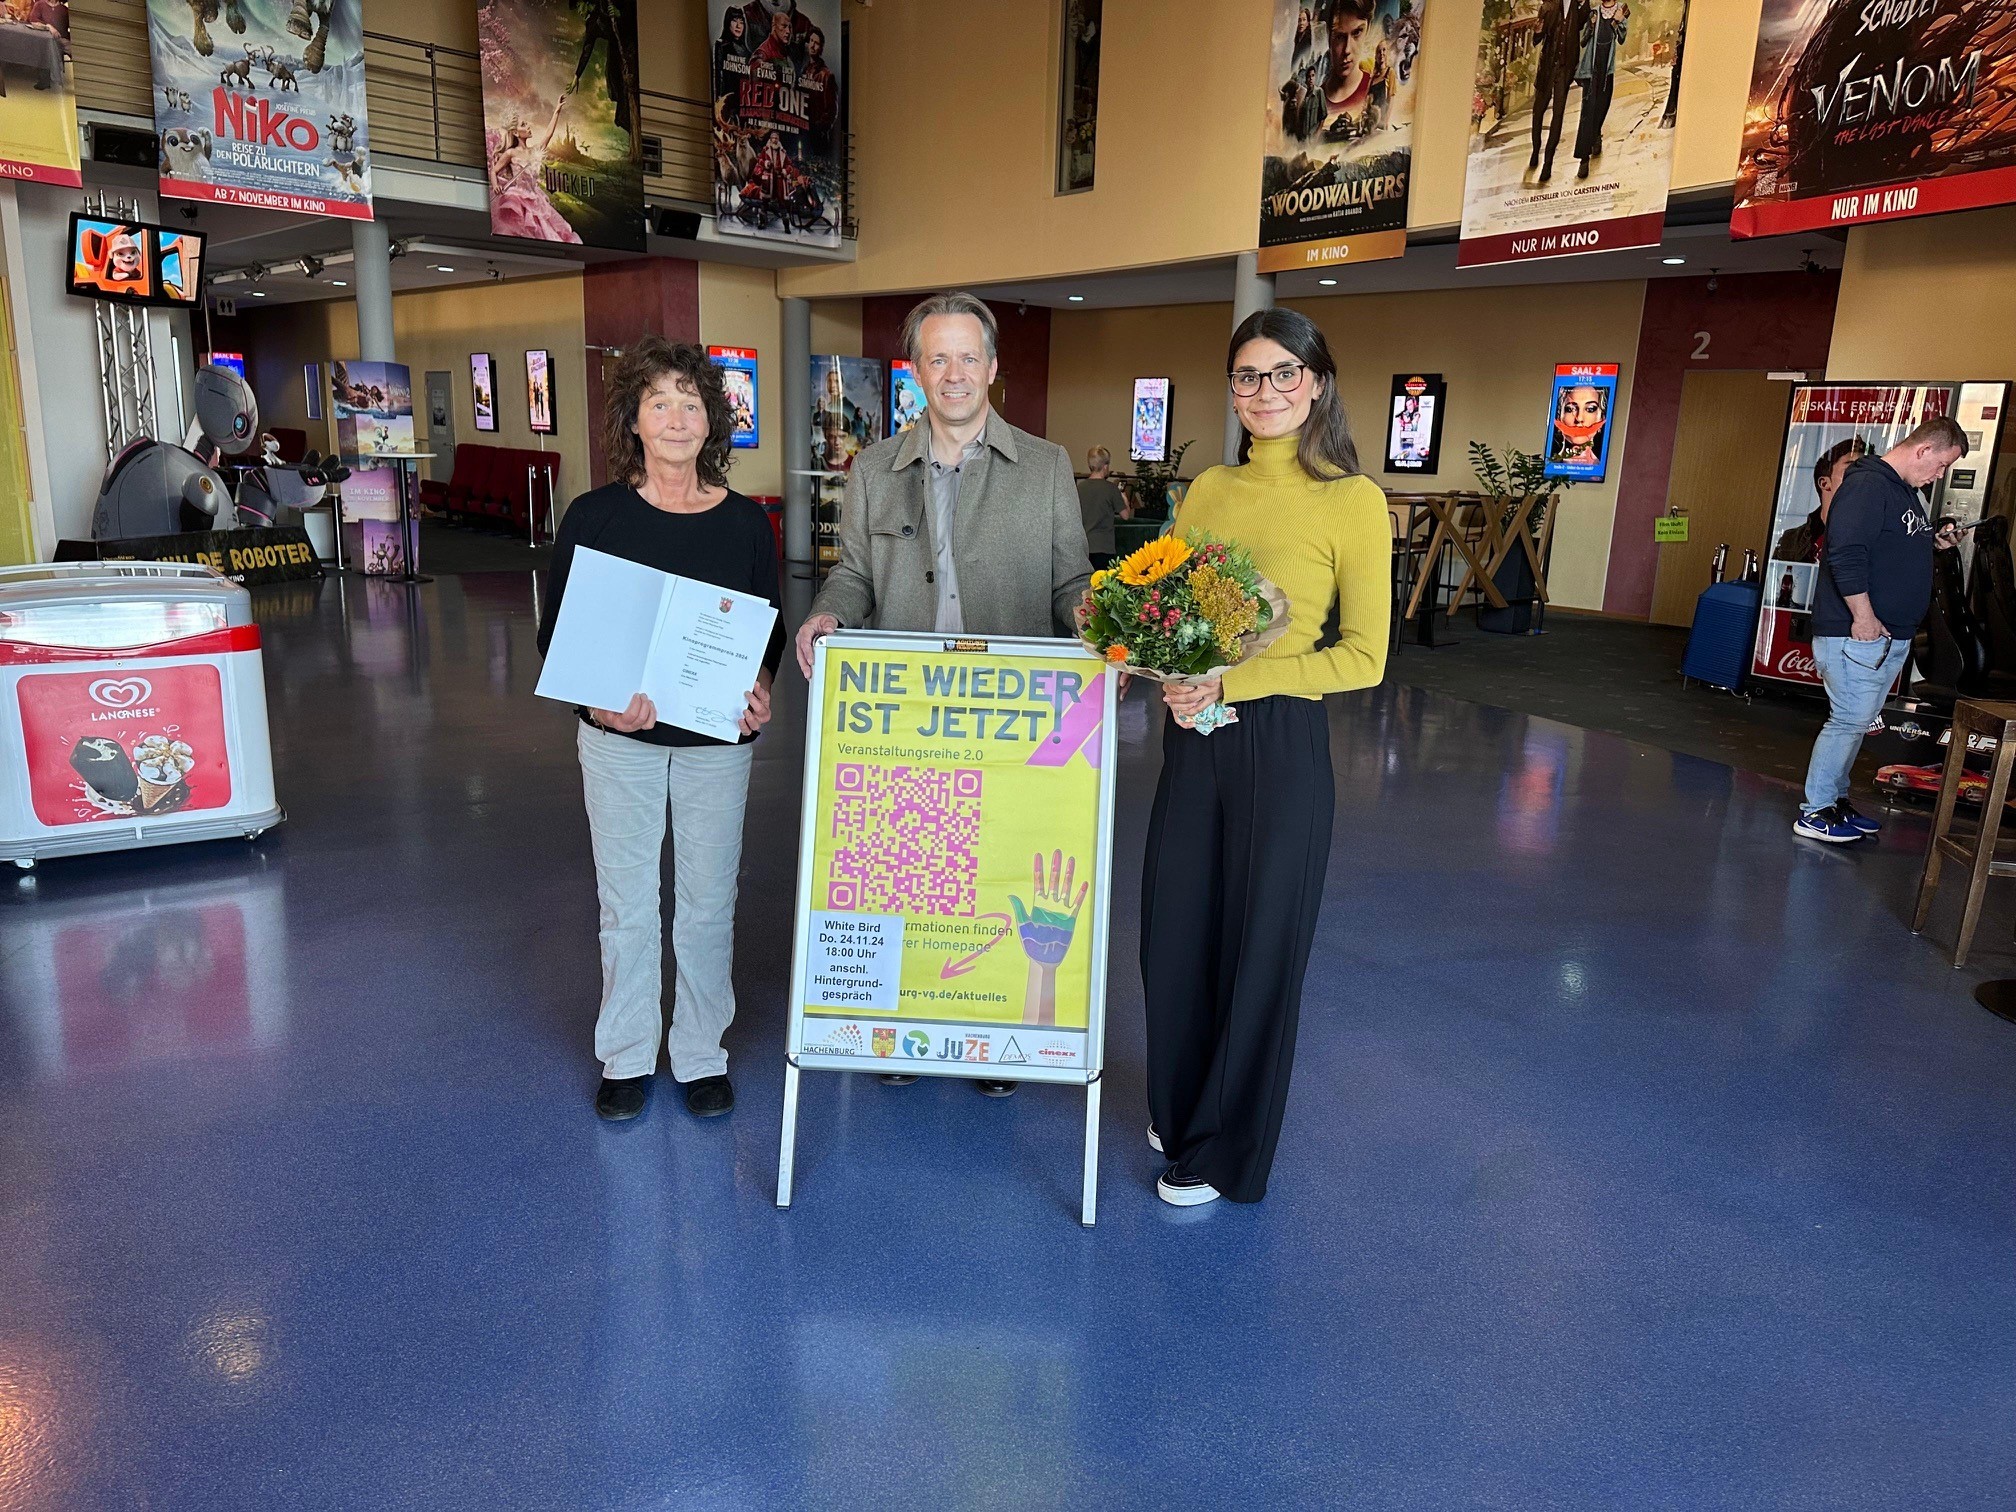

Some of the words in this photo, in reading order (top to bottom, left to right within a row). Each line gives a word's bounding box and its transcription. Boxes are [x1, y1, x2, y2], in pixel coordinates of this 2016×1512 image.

[727, 53, 746, 64] DWAYNE
[723, 60, 751, 75] JOHNSON
[757, 68, 776, 81] EVANS
[798, 77, 824, 92] SIMMONS
[1811, 49, 1984, 126] VENOM
[740, 80, 775, 108] RED
[779, 86, 810, 120] ONE
[1860, 119, 1902, 140] LAST
[1901, 109, 1949, 134] DANCE
[232, 142, 254, 155] REISE
[255, 145, 266, 156] ZU
[216, 149, 232, 160] DEN
[232, 153, 320, 177] POLARLICHTERN
[545, 164, 596, 198] WICKED
[214, 188, 228, 200] AB
[229, 191, 238, 202] 7.
[238, 191, 290, 207] NOVEMBER
[290, 196, 302, 208] IM
[303, 198, 326, 213] KINO
[1271, 172, 1406, 218] WOODWALKERS
[1530, 191, 1559, 204] BESTSELLER
[1573, 185, 1600, 196] CARSTEN
[1601, 182, 1620, 192] HENN
[1831, 194, 1860, 220] NUR
[1862, 193, 1880, 215] IM
[1882, 187, 1918, 213] KINO
[1511, 238, 1537, 255] NUR
[1541, 235, 1556, 251] IM
[1560, 230, 1599, 248] KINO
[1307, 248, 1318, 262] IM
[1321, 245, 1349, 260] KINO
[1690, 331, 1711, 360] 2
[1571, 366, 1594, 376] SAAL
[1596, 366, 1602, 375] 2
[1799, 401, 1847, 413] EISKALT
[1851, 401, 1939, 413] ERFRISHN.
[349, 488, 361, 496] IM
[363, 488, 386, 496] KINO
[229, 542, 313, 571] ROBOTER
[682, 635, 735, 656] Kinoprogrammpreis
[735, 652, 748, 661] 2024
[839, 661, 908, 695] NIE
[922, 665, 1083, 703] WIEDER
[837, 701, 900, 735] IST
[917, 700, 1061, 744] JETZT!
[1889, 725, 1931, 738] UNIVERSAL
[837, 743, 960, 761] Veranstaltungsreihe
[963, 750, 984, 762] 2.0
[824, 920, 857, 933] White
[858, 921, 881, 933] Bird
[973, 922, 1013, 937] finden
[819, 933, 837, 945] Do.
[840, 934, 884, 947] 24.11.24
[922, 938, 992, 954] Homepage
[825, 947, 854, 959] 18:00
[856, 948, 877, 960] Uhr
[829, 963, 869, 976] anschl.
[814, 975, 883, 990] Hintergrund-
[822, 989, 872, 1003] gespräch
[900, 988, 1008, 1003] urg-vg.de/aktuelles
[803, 1046, 855, 1056] HACHENBURG
[1038, 1048, 1076, 1057] cinexx
